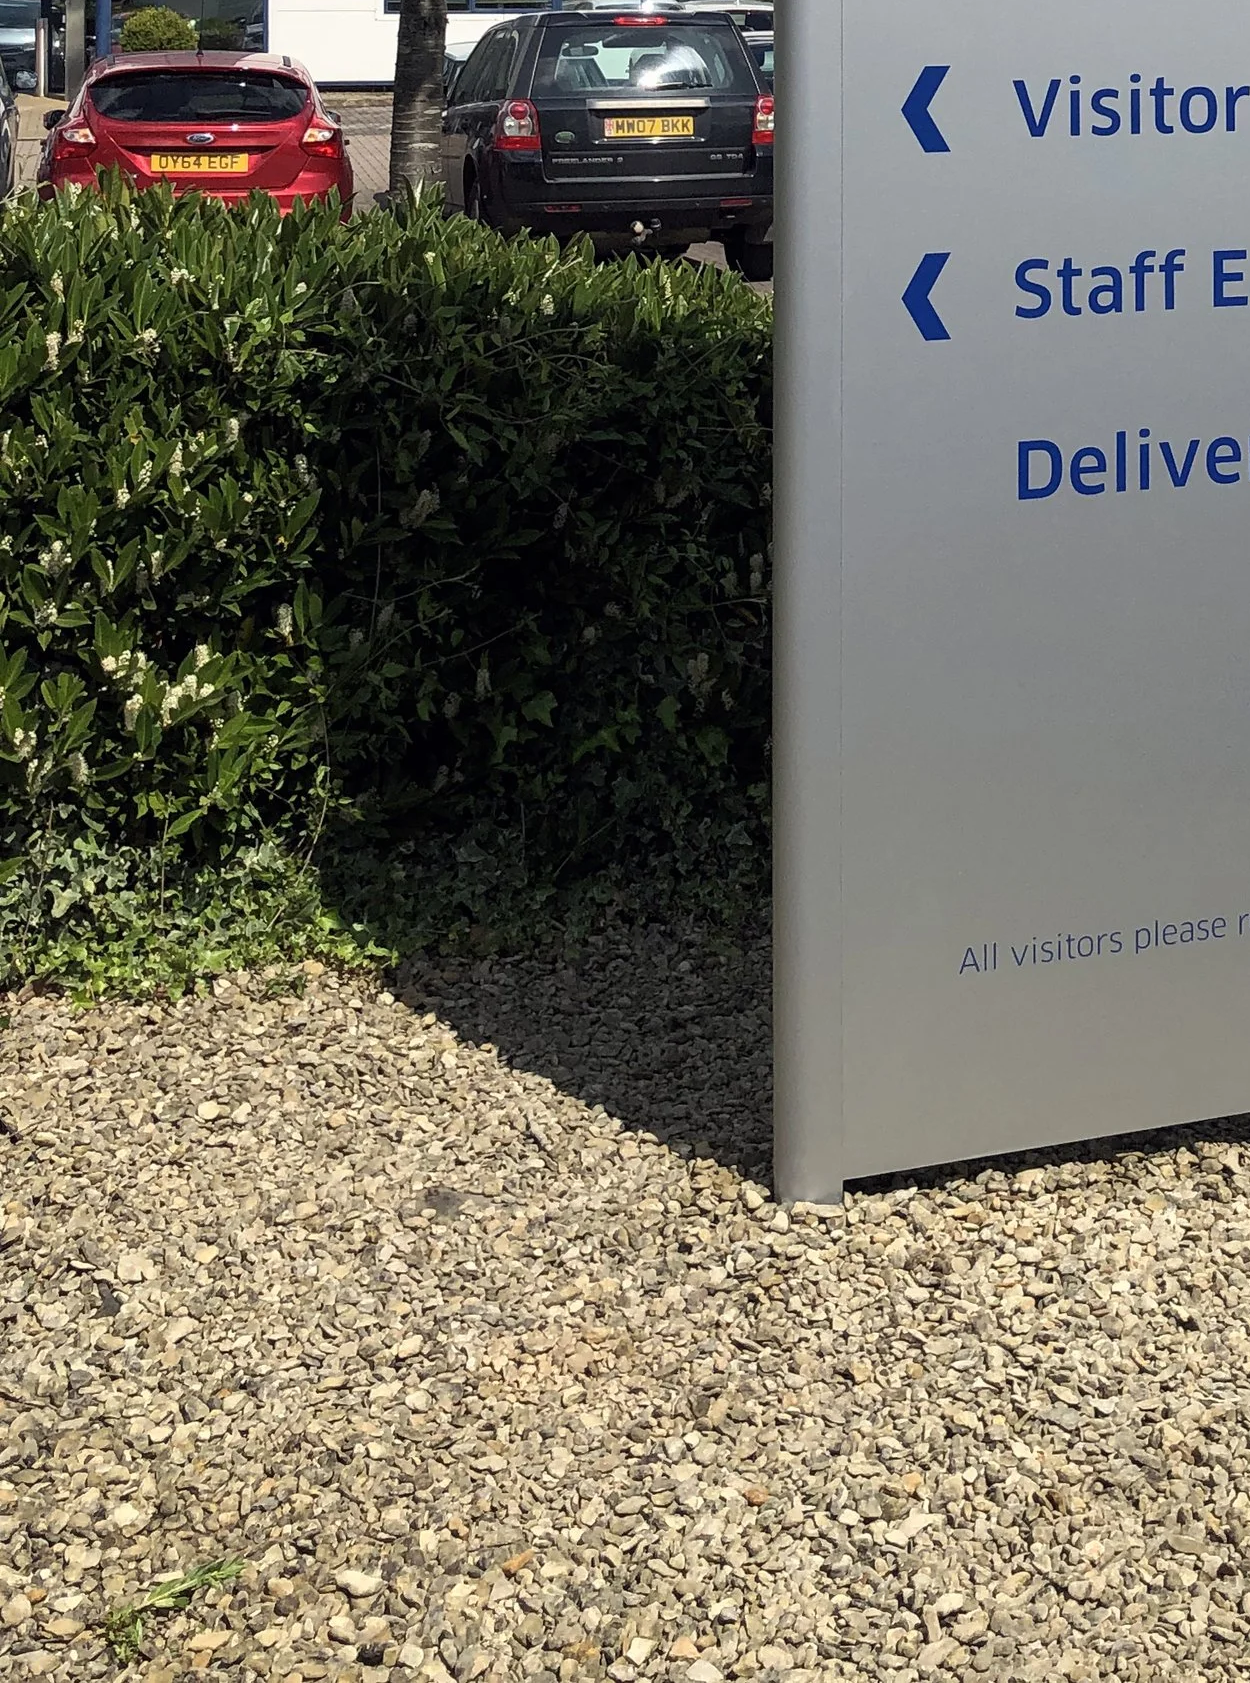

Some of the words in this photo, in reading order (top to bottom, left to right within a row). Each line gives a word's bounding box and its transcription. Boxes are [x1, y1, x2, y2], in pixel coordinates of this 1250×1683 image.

[615, 119, 656, 134] MW07
[661, 118, 691, 133] BKK
[1013, 74, 1250, 137] Visitor
[208, 155, 241, 169] EGF
[1014, 249, 1186, 319] Staff
[959, 942, 998, 974] All
[1011, 929, 1123, 967] visitors
[1134, 914, 1227, 954] please
